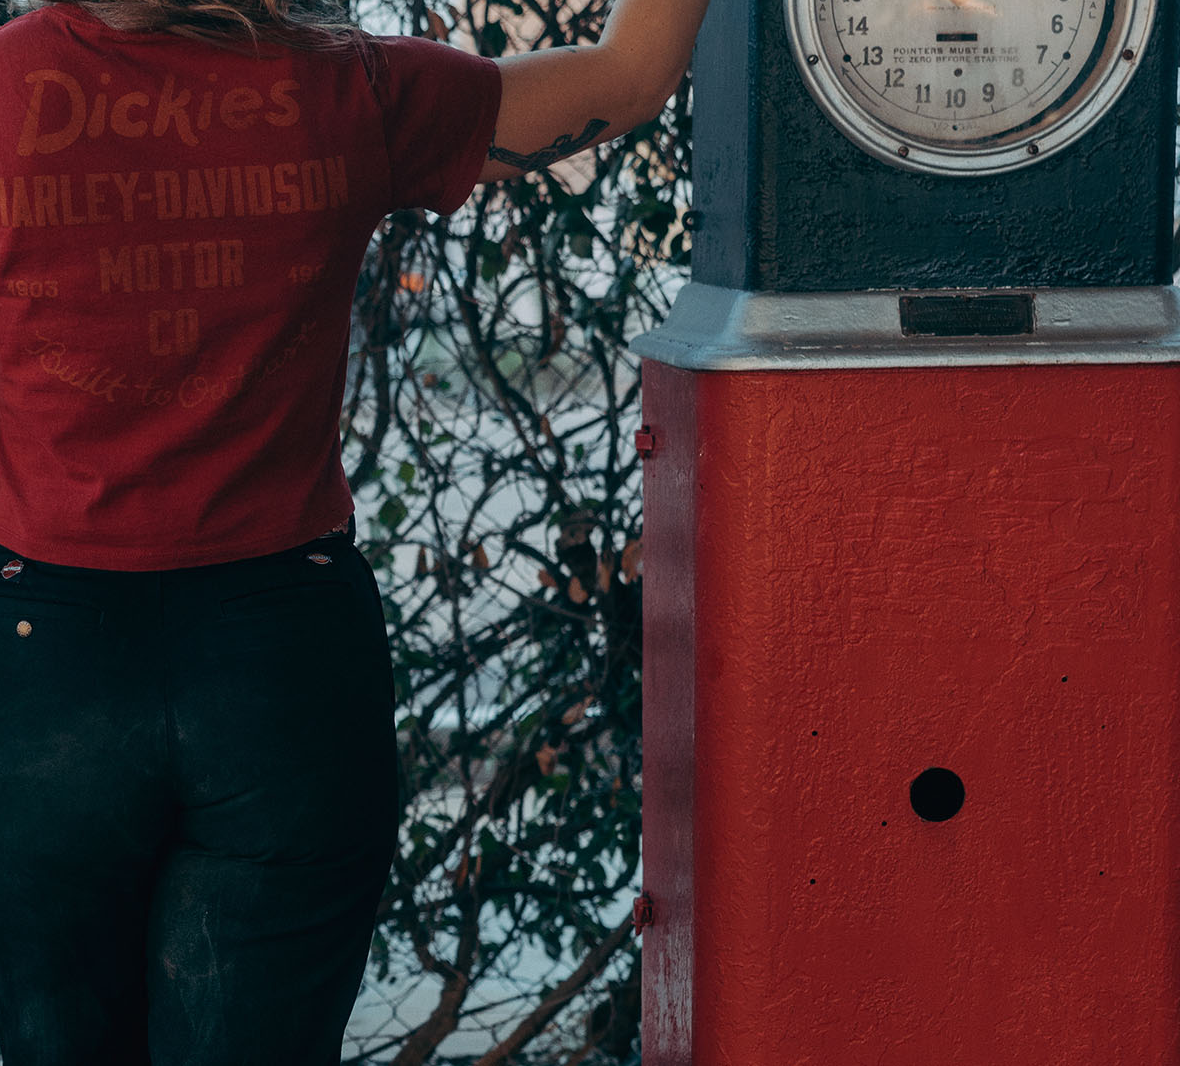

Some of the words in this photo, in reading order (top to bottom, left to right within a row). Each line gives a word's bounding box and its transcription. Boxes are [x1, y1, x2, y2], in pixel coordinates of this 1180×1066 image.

[847, 15, 869, 35] 14
[1051, 14, 1063, 34] 6
[862, 46, 883, 66] 13
[893, 56, 905, 64] TO
[909, 56, 932, 64] ZERO
[936, 56, 971, 64] BEFORE
[975, 56, 1019, 64] STARTING
[1036, 45, 1048, 65] 7
[885, 68, 905, 88] 12
[1012, 67, 1025, 87] 8
[916, 84, 932, 104] 11
[945, 88, 967, 109] 10
[982, 82, 995, 102] 9
[18, 69, 301, 156] Dickies
[99, 239, 245, 294] MOTOR
[7, 279, 59, 299] 1903
[148, 308, 199, 356] CO
[25, 330, 127, 403] Built
[134, 380, 173, 408] to
